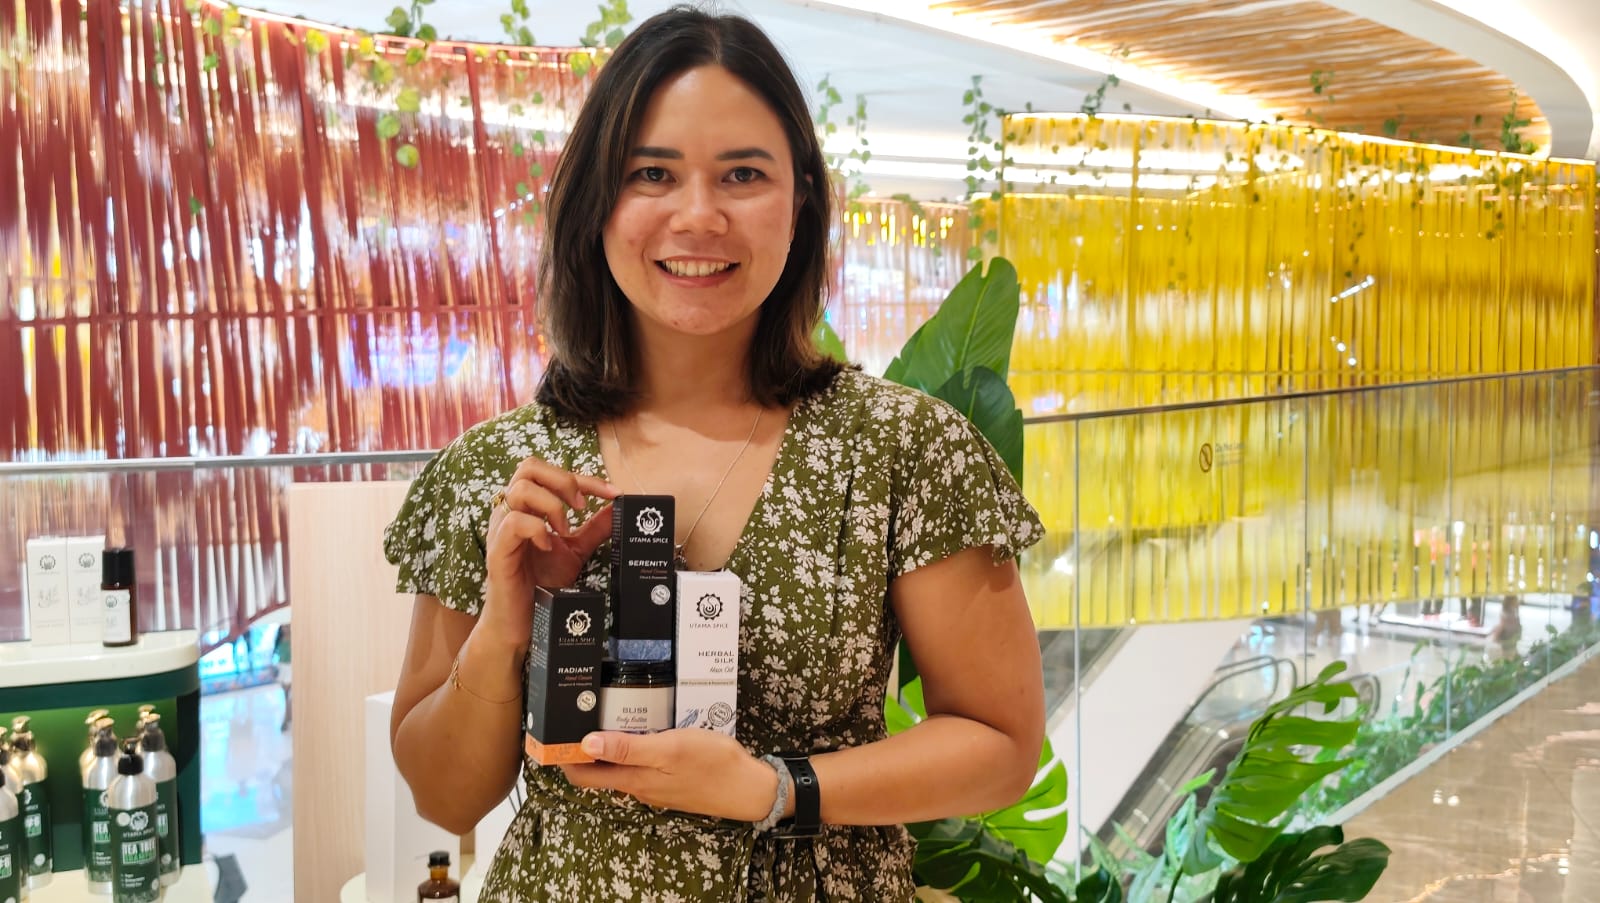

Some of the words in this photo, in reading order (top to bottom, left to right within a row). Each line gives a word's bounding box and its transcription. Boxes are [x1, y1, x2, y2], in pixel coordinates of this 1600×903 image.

[628, 559, 668, 567] SERENITY
[557, 666, 594, 674] RADIANT
[622, 706, 648, 714] BLISS
